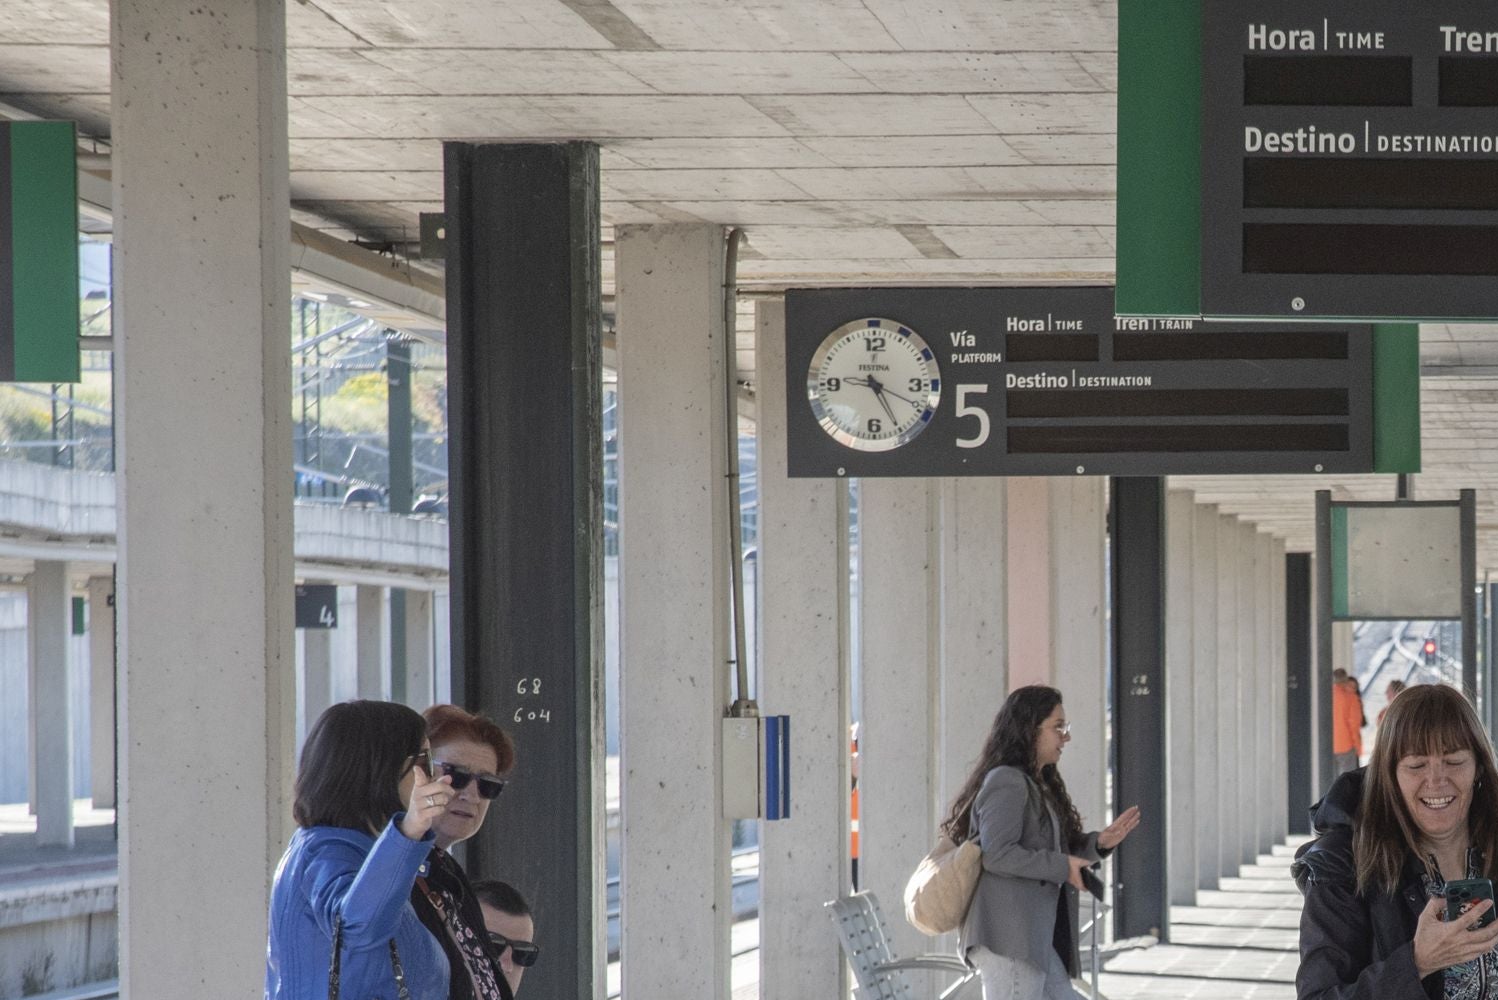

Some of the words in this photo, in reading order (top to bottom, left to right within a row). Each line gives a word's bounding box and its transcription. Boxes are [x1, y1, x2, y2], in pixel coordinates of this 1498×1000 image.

[1248, 24, 1316, 50] Hora
[1335, 32, 1385, 49] TIME
[1244, 124, 1356, 153] Destino
[1006, 317, 1045, 332] Hora
[1055, 320, 1083, 331] TIME
[1115, 318, 1149, 331] Tren
[1159, 319, 1193, 331] TRAIN
[863, 337, 886, 352] 12
[950, 330, 976, 347] Vía
[951, 353, 1002, 364] PLATFORM
[858, 364, 890, 372] FESTINA
[826, 377, 841, 392] 9
[908, 378, 922, 392] 3
[1006, 372, 1069, 389] Destino
[1079, 376, 1152, 388] DESTINATION
[955, 383, 991, 449] 5
[867, 418, 882, 433] 6
[319, 604, 336, 628] 4
